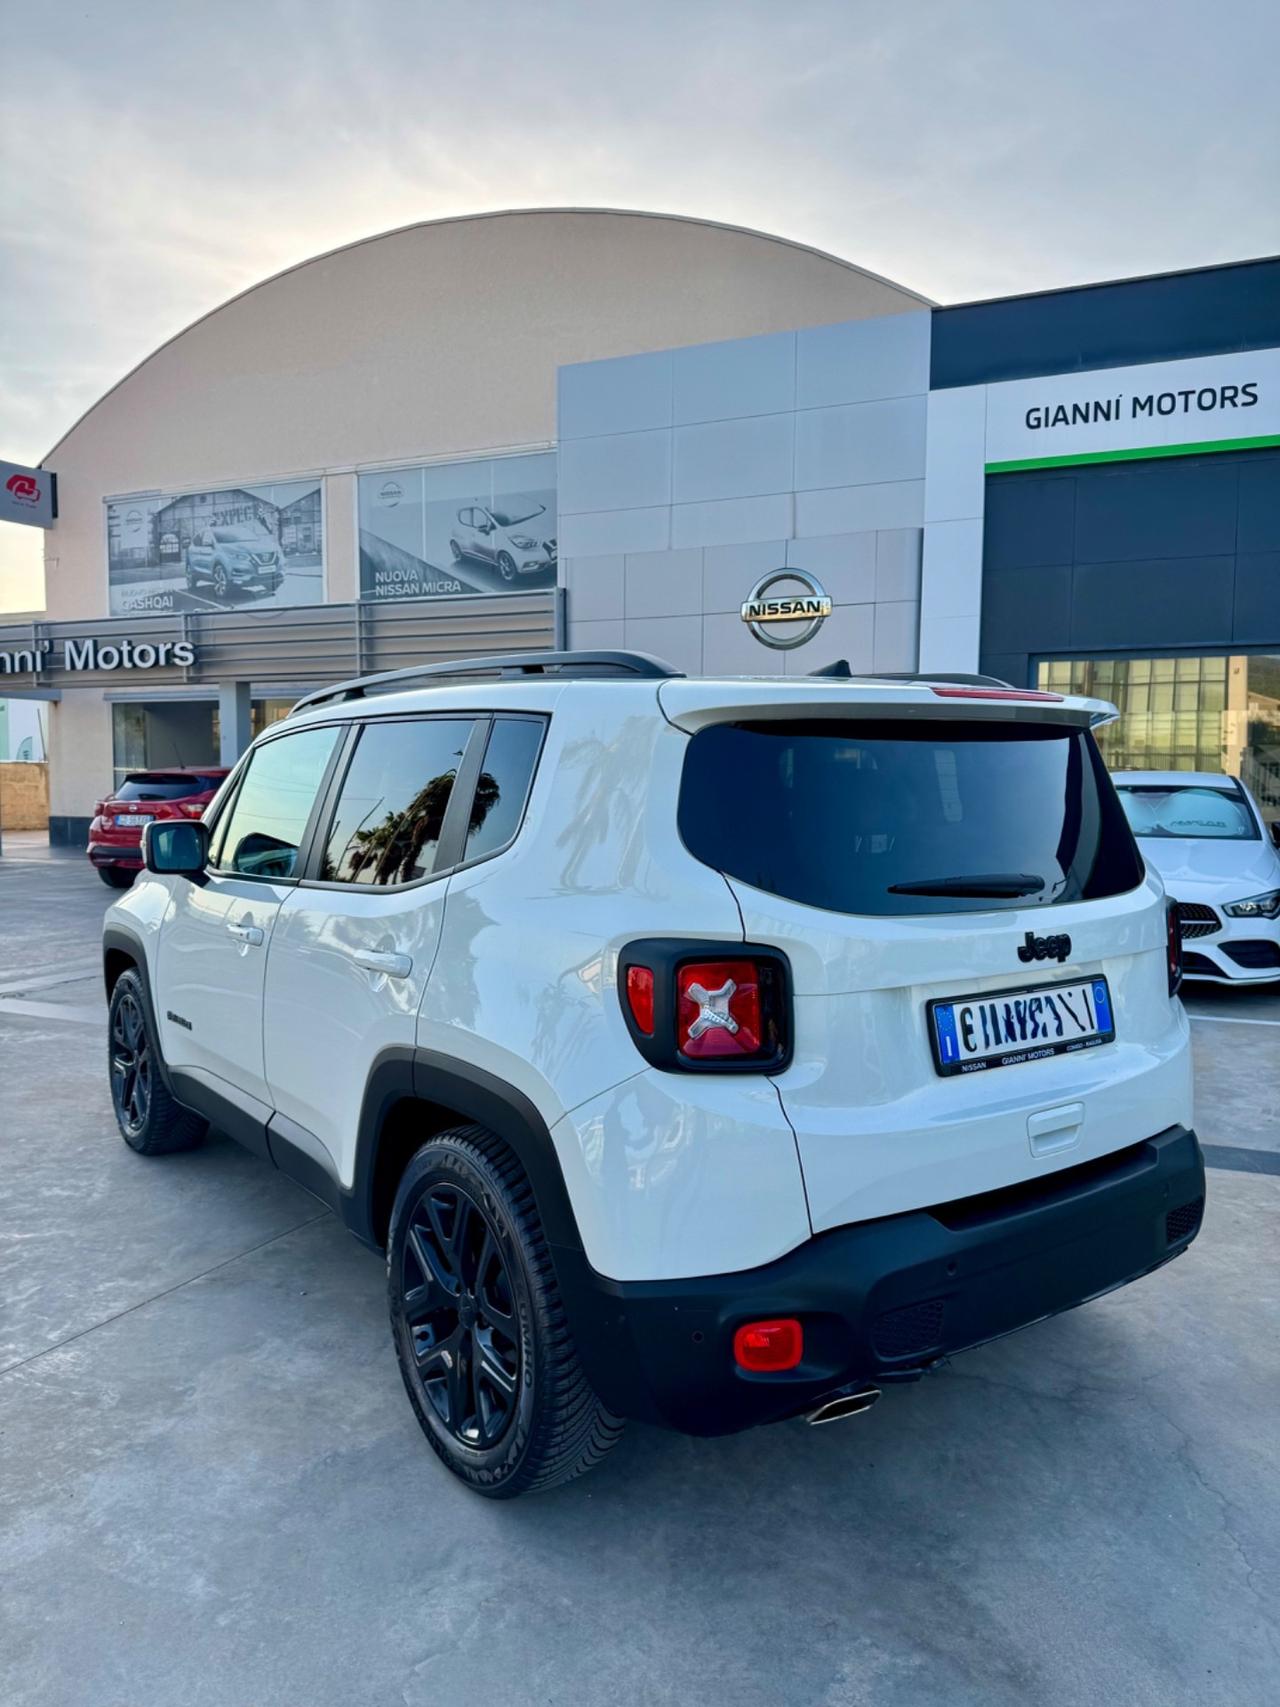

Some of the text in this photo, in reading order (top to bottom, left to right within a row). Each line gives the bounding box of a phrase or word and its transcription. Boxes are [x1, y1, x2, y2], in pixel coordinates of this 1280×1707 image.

[1132, 383, 1258, 418] MOTORS
[375, 570, 418, 582] NUOVA
[375, 581, 461, 596] NISSAN MICRA
[749, 600, 820, 617] NISSAN
[64, 639, 195, 671] Motors
[1017, 932, 1072, 963] Jeep
[1027, 1047, 1055, 1060] MOTORS
